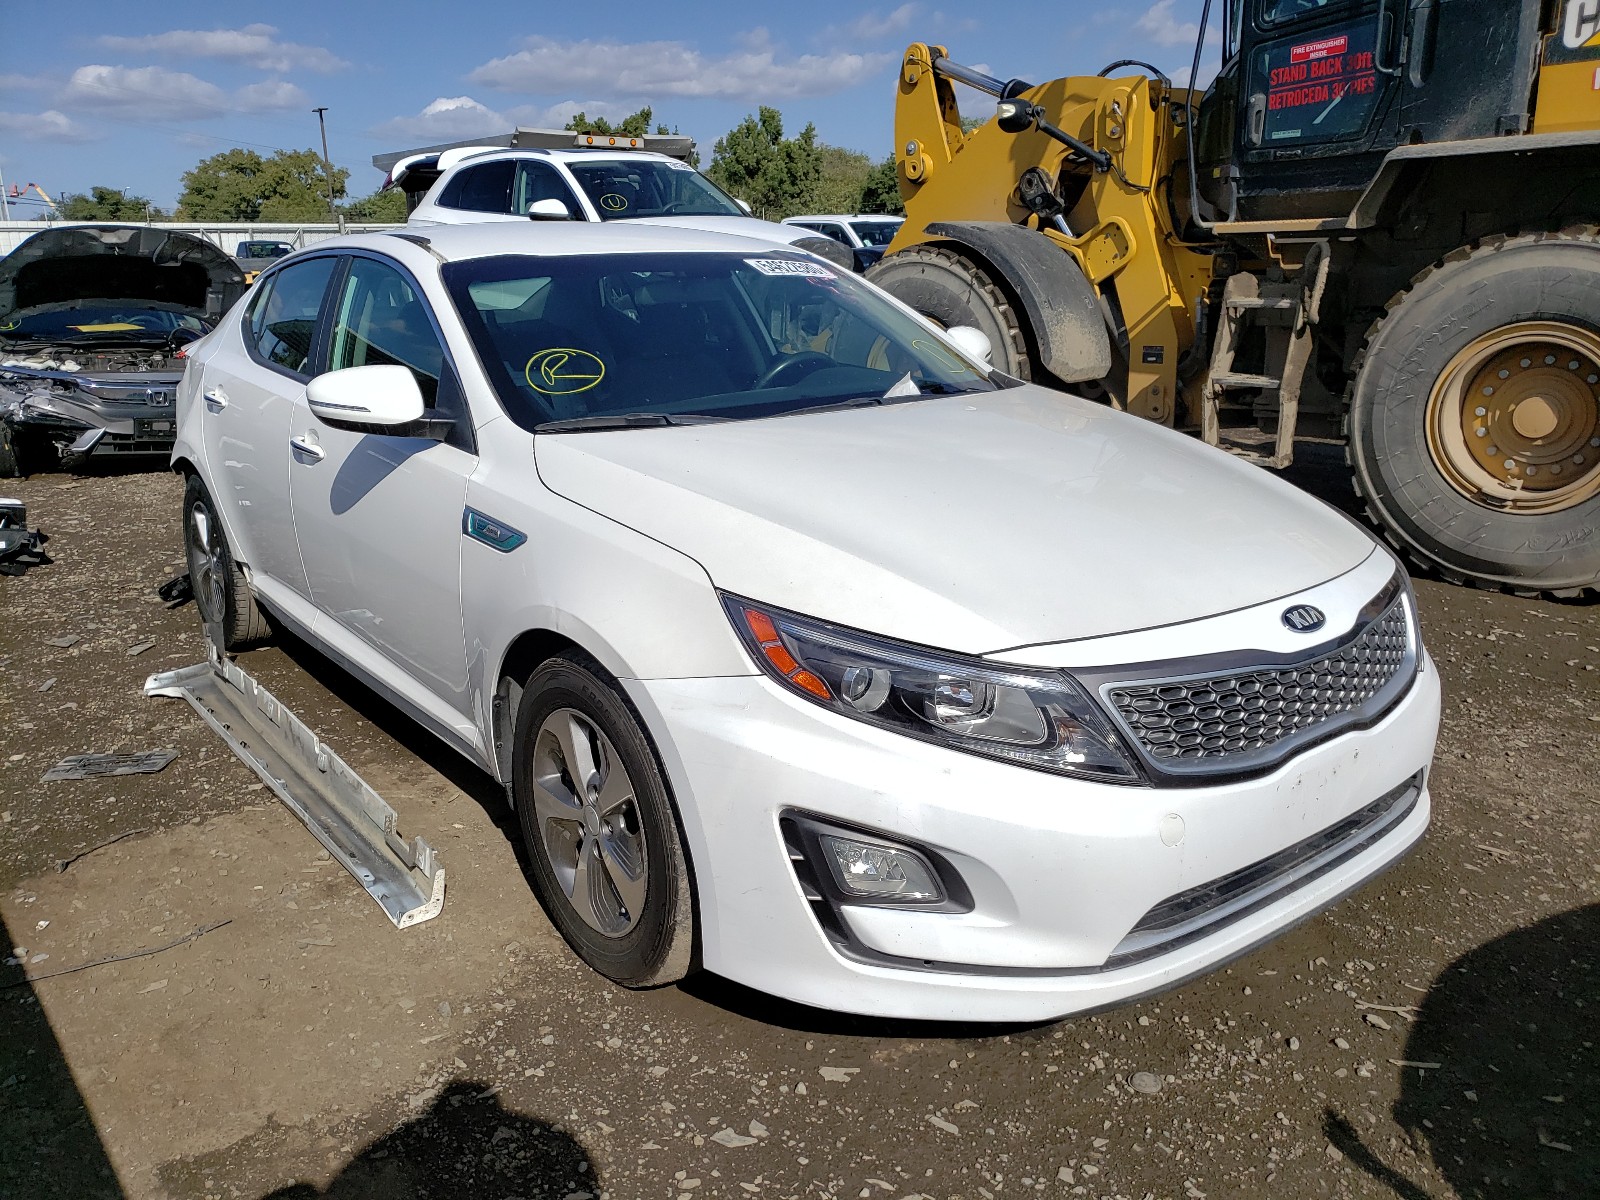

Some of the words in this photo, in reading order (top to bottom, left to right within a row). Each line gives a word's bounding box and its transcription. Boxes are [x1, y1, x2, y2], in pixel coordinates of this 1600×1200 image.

[1293, 46, 1306, 55] FIRE
[1306, 38, 1345, 52] EXTINGUISHER
[1309, 49, 1328, 59] INSIDE
[1269, 63, 1307, 86] STAND
[1311, 56, 1343, 78] BACK
[1268, 84, 1329, 110] RETROCEDA
[1286, 606, 1324, 629] KIA
